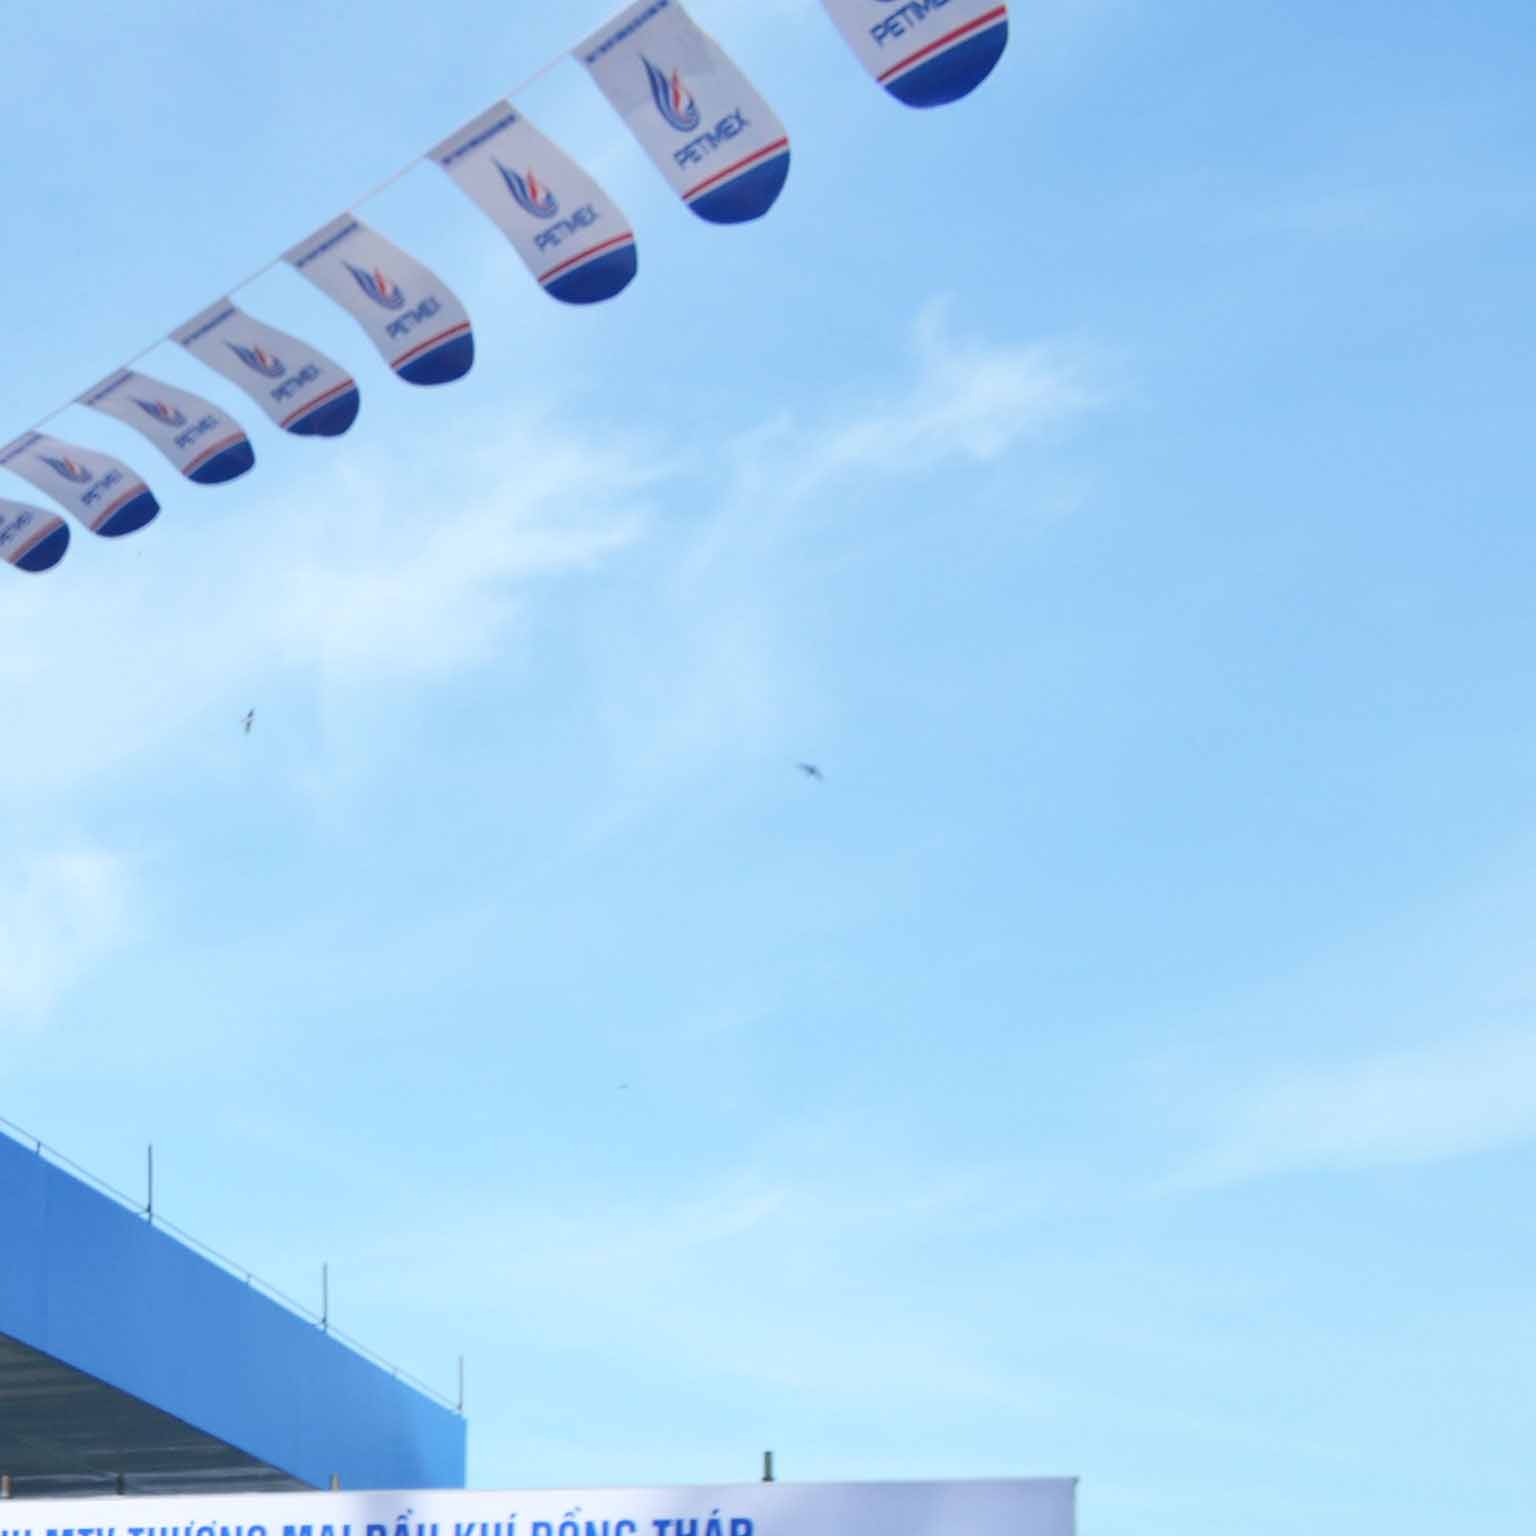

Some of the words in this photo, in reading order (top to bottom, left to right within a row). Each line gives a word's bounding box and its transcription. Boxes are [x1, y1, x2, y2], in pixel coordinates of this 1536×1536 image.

[871, 0, 950, 46] PETIM
[673, 108, 748, 170] PETIMEX
[533, 205, 598, 251] PETIMEX
